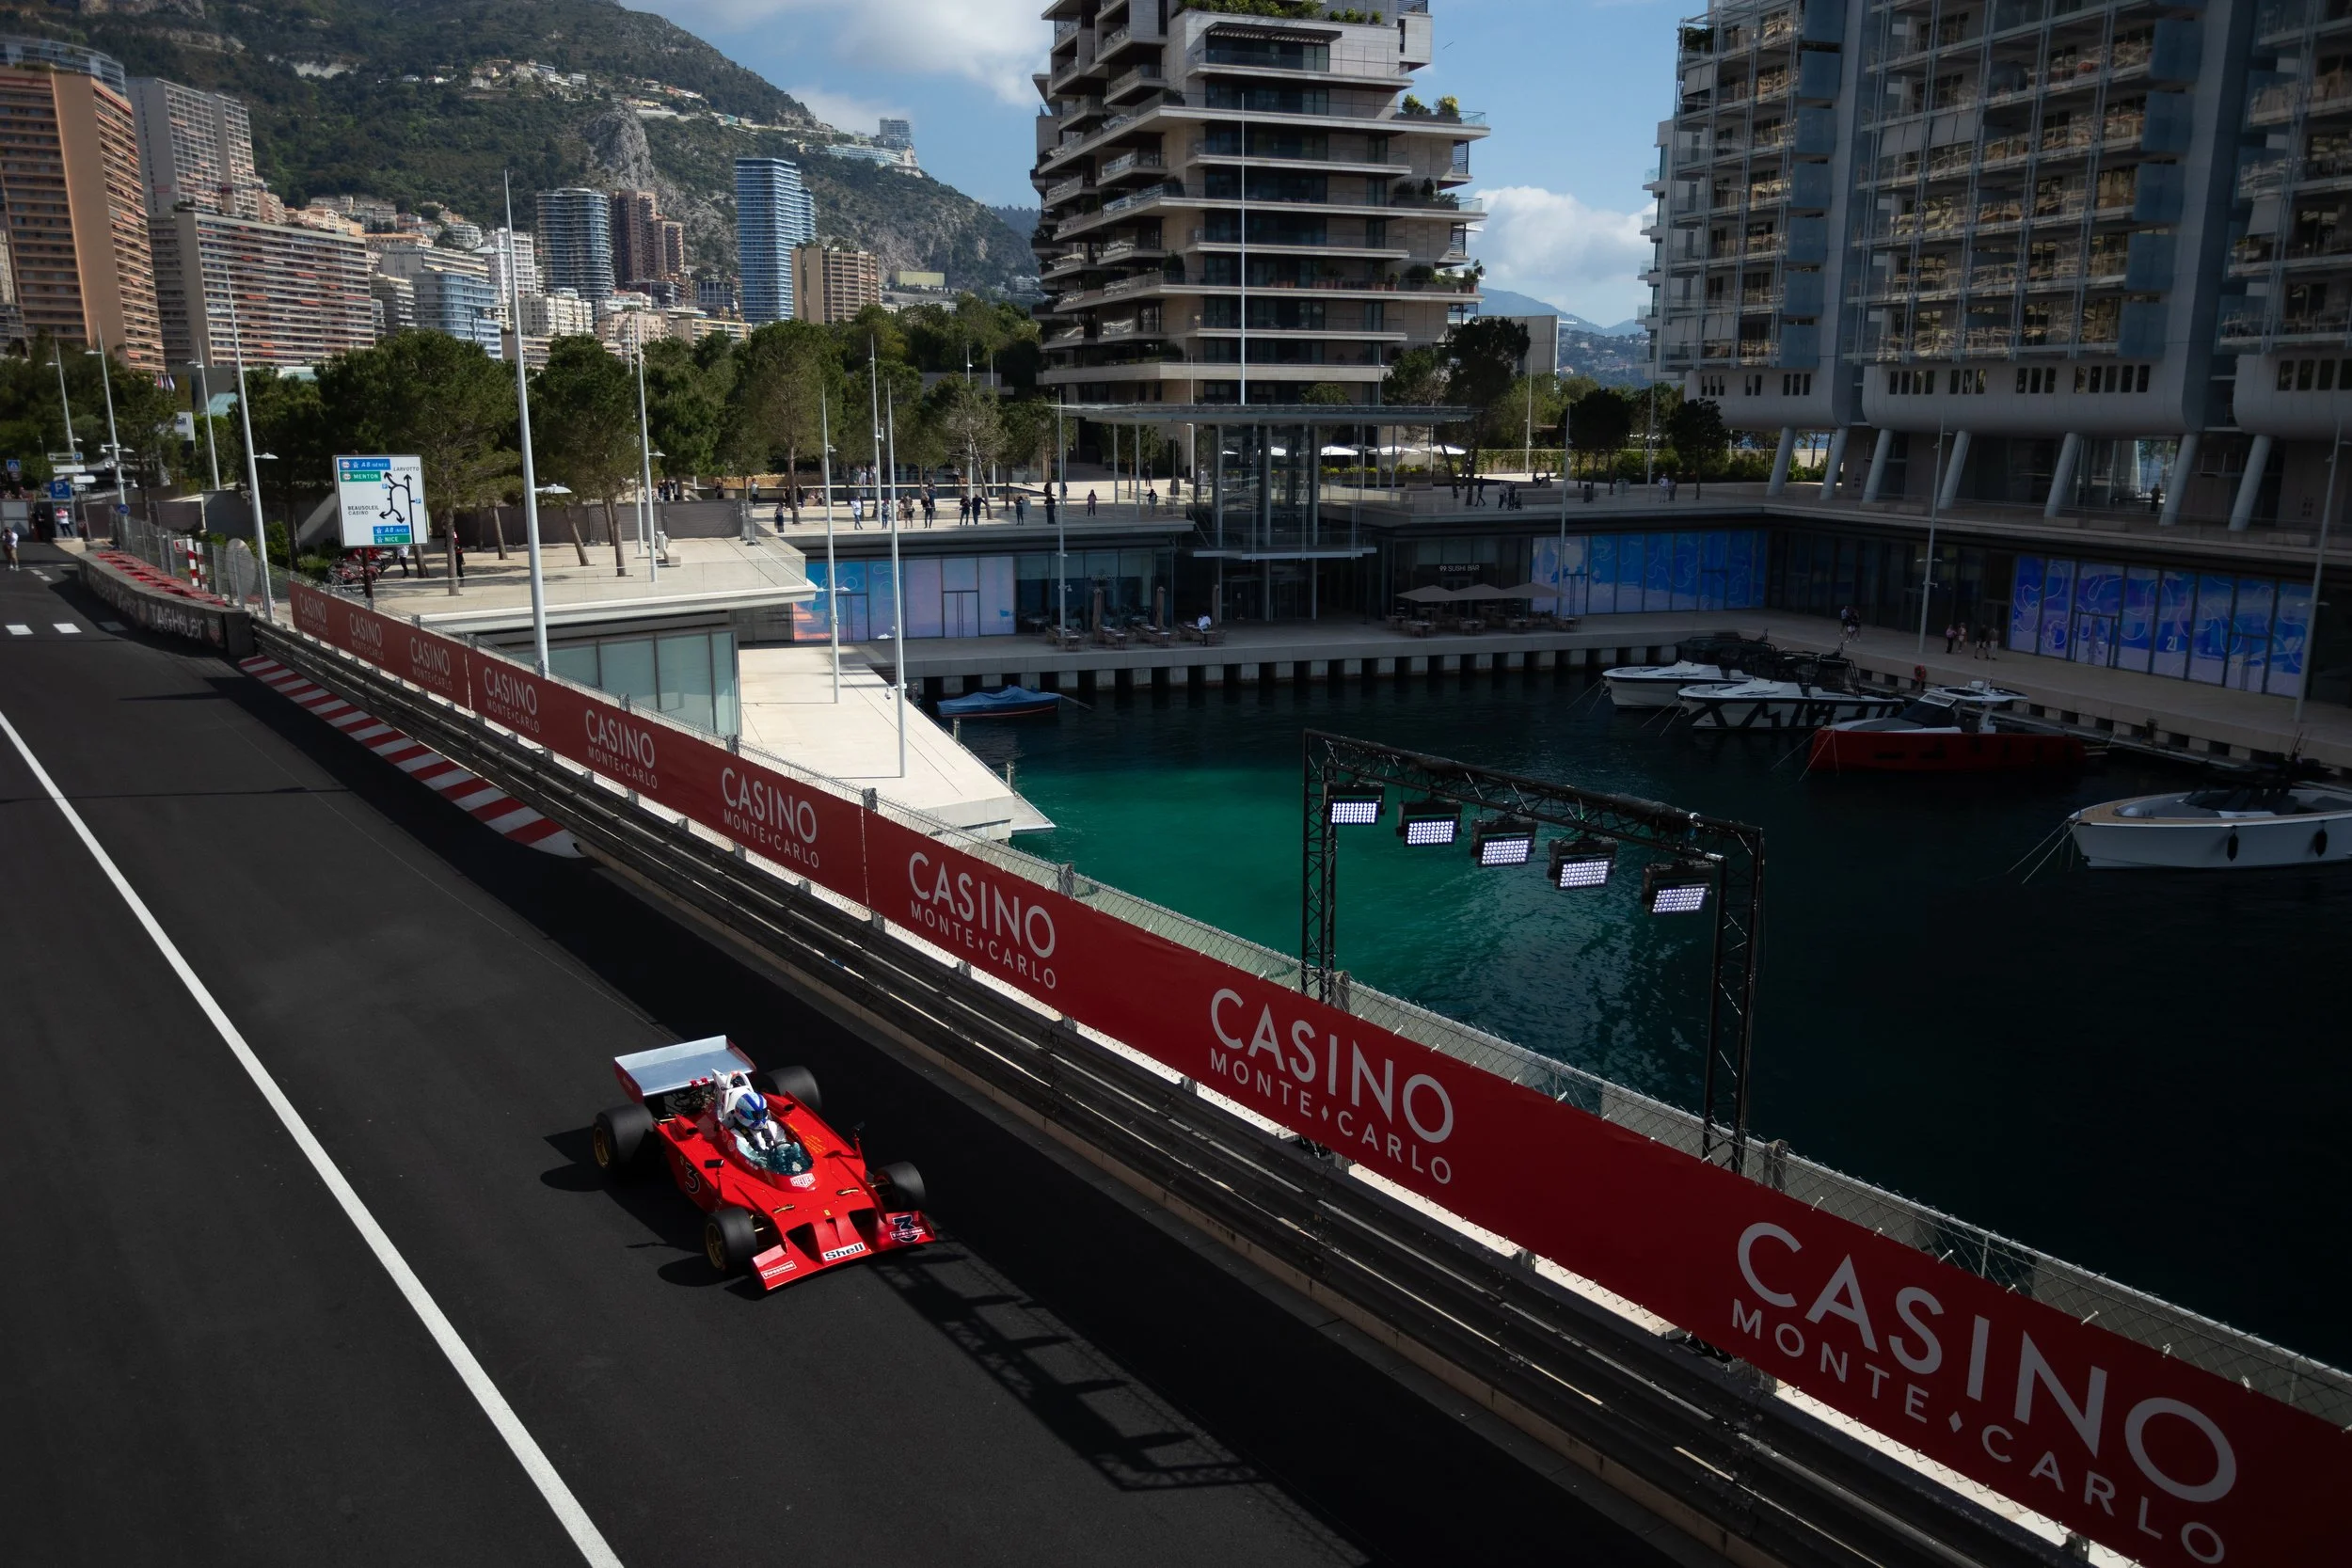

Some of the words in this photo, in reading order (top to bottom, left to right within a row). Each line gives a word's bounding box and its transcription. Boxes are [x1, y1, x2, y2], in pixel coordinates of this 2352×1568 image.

[299, 593, 327, 625] CASINO
[349, 612, 383, 648] CASINO
[2166, 635, 2178, 651] 21
[410, 637, 451, 676] CASINO
[485, 667, 537, 716] CASINO
[585, 709, 656, 768] CASINO
[722, 767, 817, 844] CASINO
[908, 851, 1056, 958] CASINO
[1211, 988, 1454, 1144] CASINO
[685, 1162, 700, 1195] 3
[792, 1174, 814, 1186] HEUER
[893, 1215, 919, 1243] 3
[763, 1262, 795, 1277] Firestone
[825, 1243, 864, 1260] Shell
[1737, 1222, 2237, 1503] CASINO
